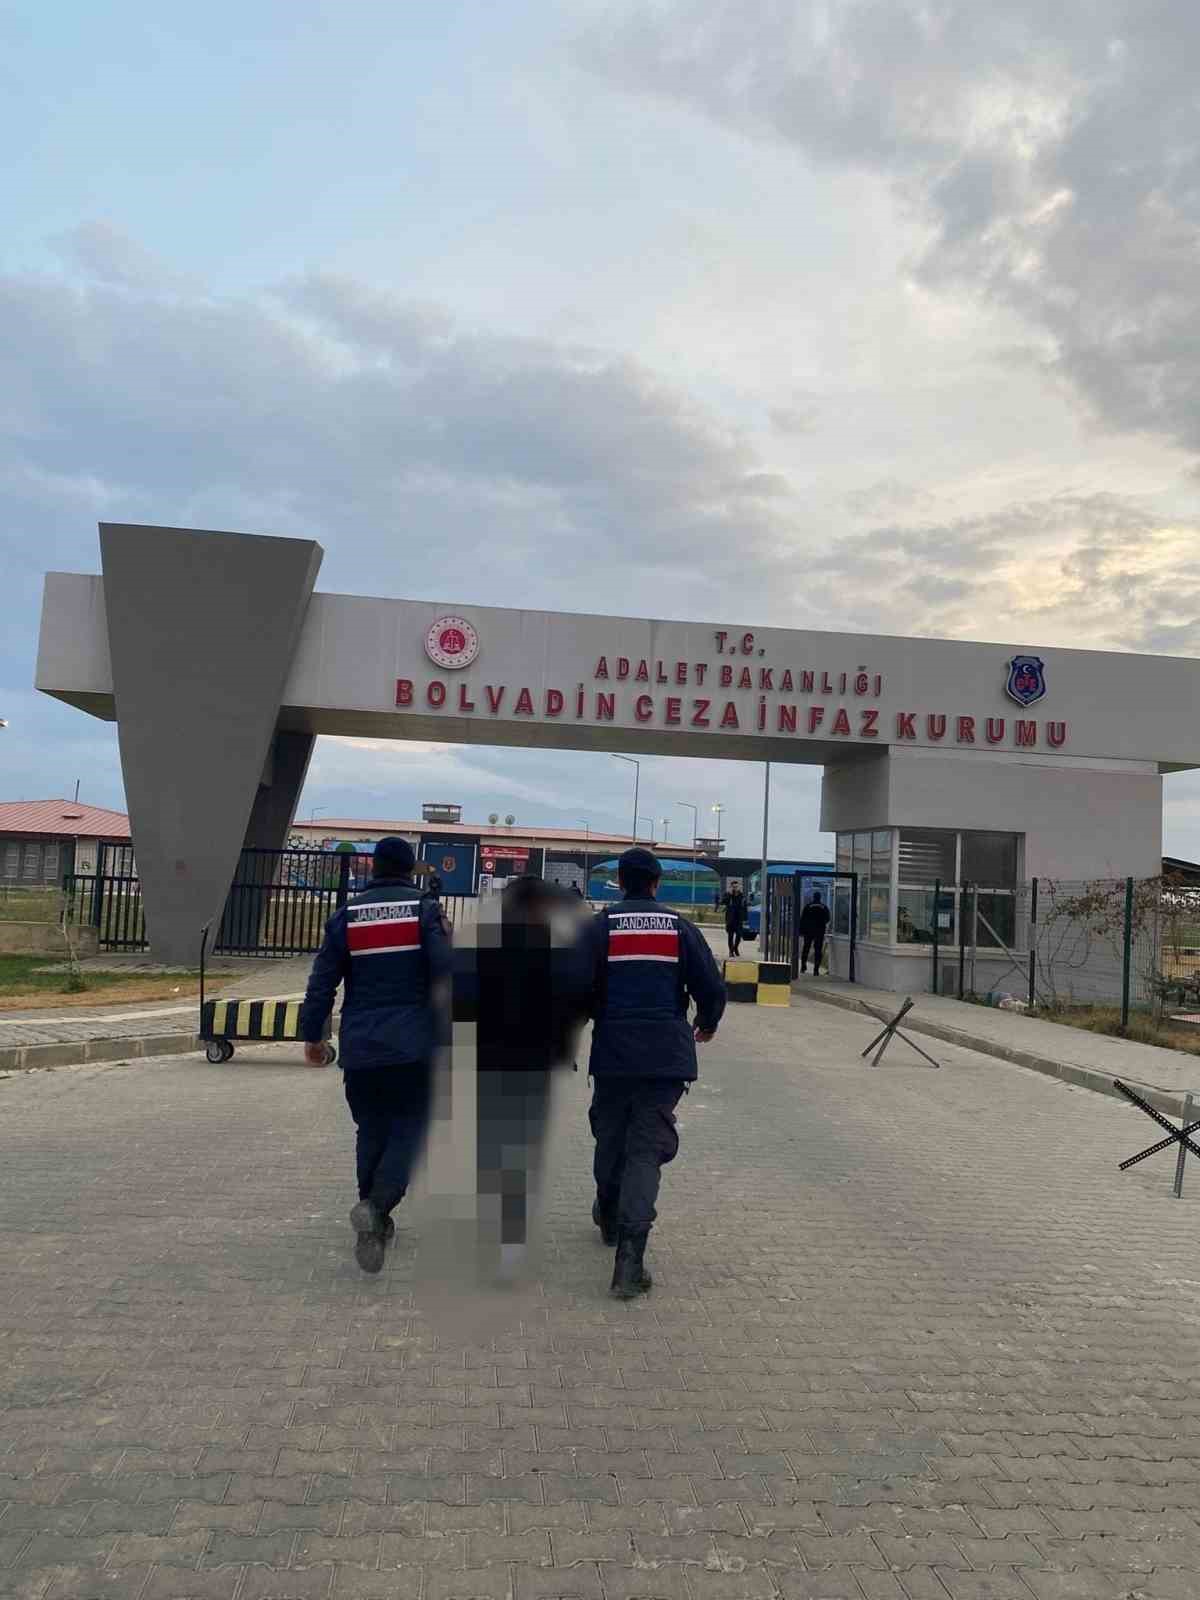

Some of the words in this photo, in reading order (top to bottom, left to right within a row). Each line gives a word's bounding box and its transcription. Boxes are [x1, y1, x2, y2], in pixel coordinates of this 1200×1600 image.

[714, 631, 765, 657] T.C.
[594, 656, 708, 685] ADALET
[719, 664, 881, 697] BAKANLIĞI
[395, 679, 615, 721] BOLVADİN
[634, 694, 740, 729] CEZA
[757, 695, 879, 738] İNFAZ
[896, 712, 1066, 747] KURUMU
[353, 905, 413, 922] JANDARMA
[616, 917, 674, 929] JANDARMA
